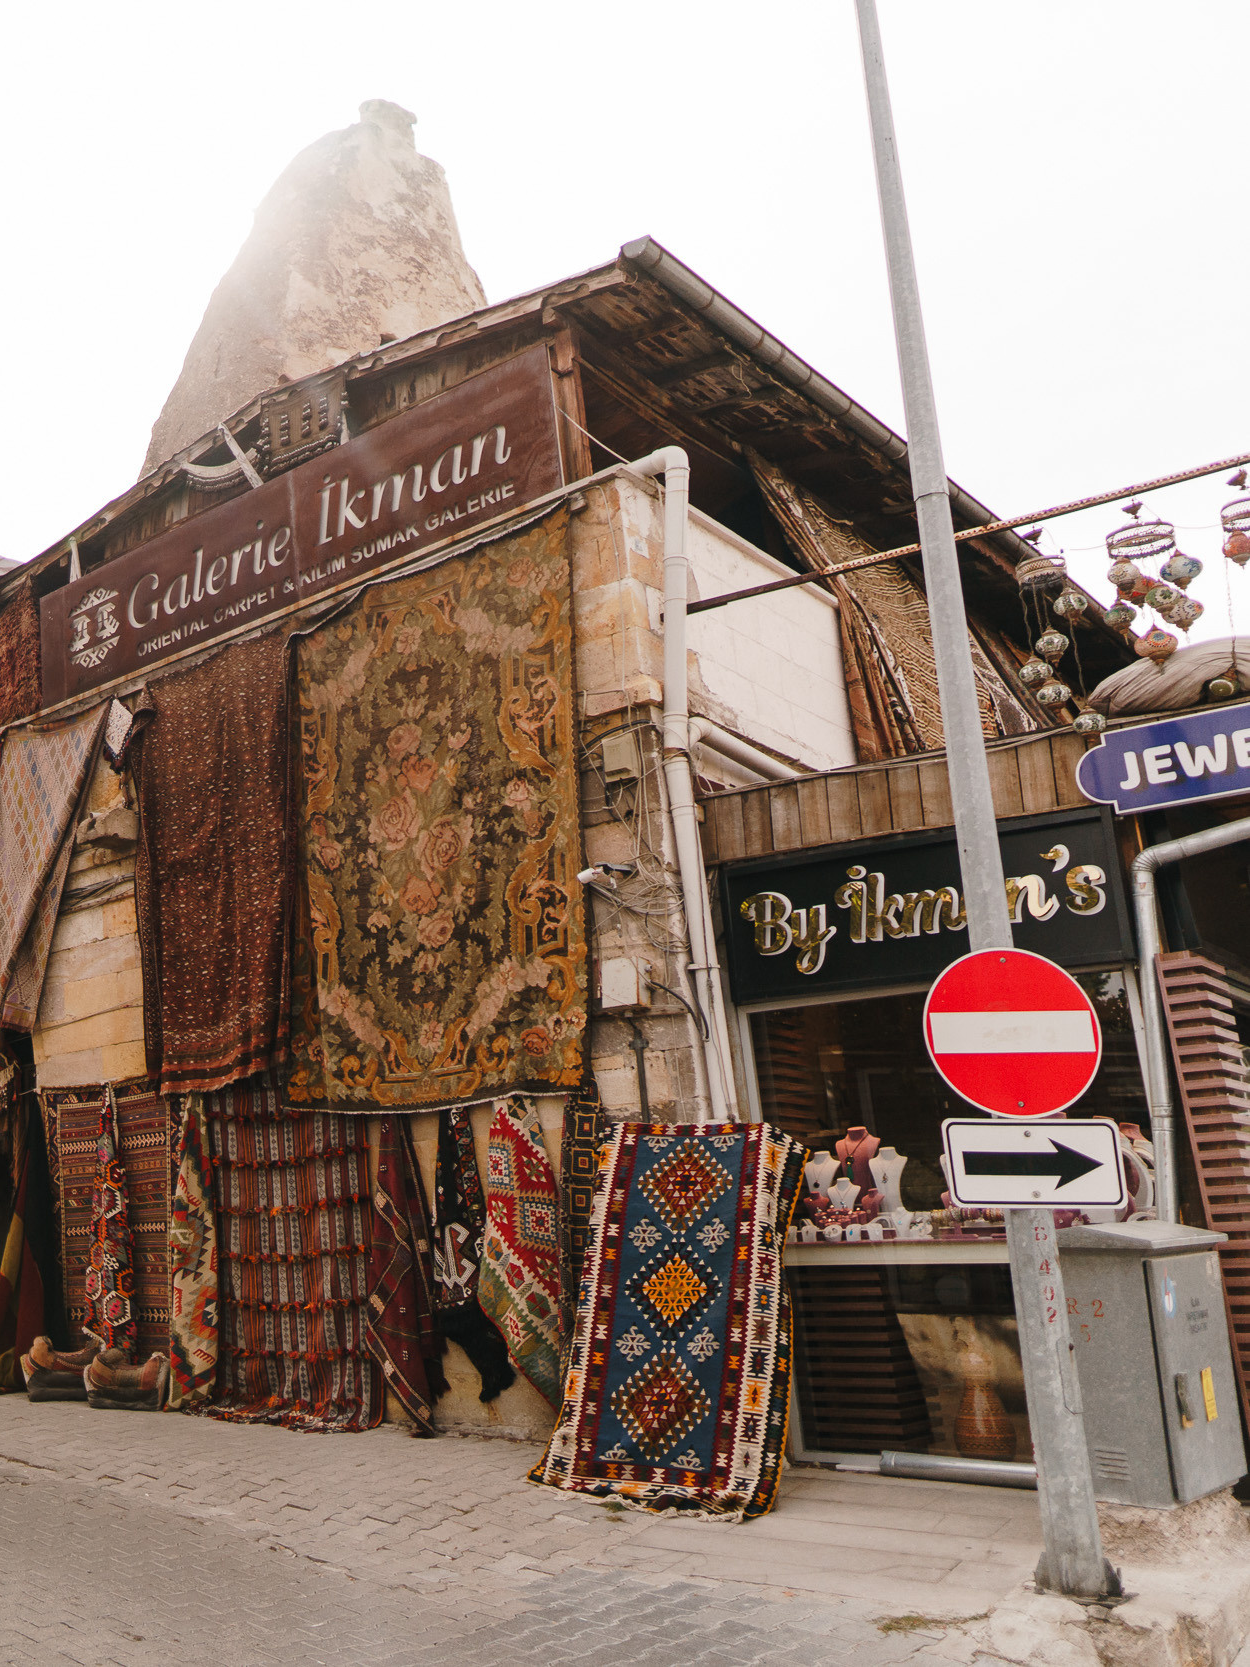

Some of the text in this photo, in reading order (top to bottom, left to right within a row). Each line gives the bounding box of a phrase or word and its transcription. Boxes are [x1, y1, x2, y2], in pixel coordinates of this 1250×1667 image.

[127, 519, 292, 629] Galerie
[137, 478, 517, 657] ORIENTAL CARPET & KILIM SUMAK GALERIE
[1119, 727, 1250, 790] JEWE
[739, 891, 838, 975] By
